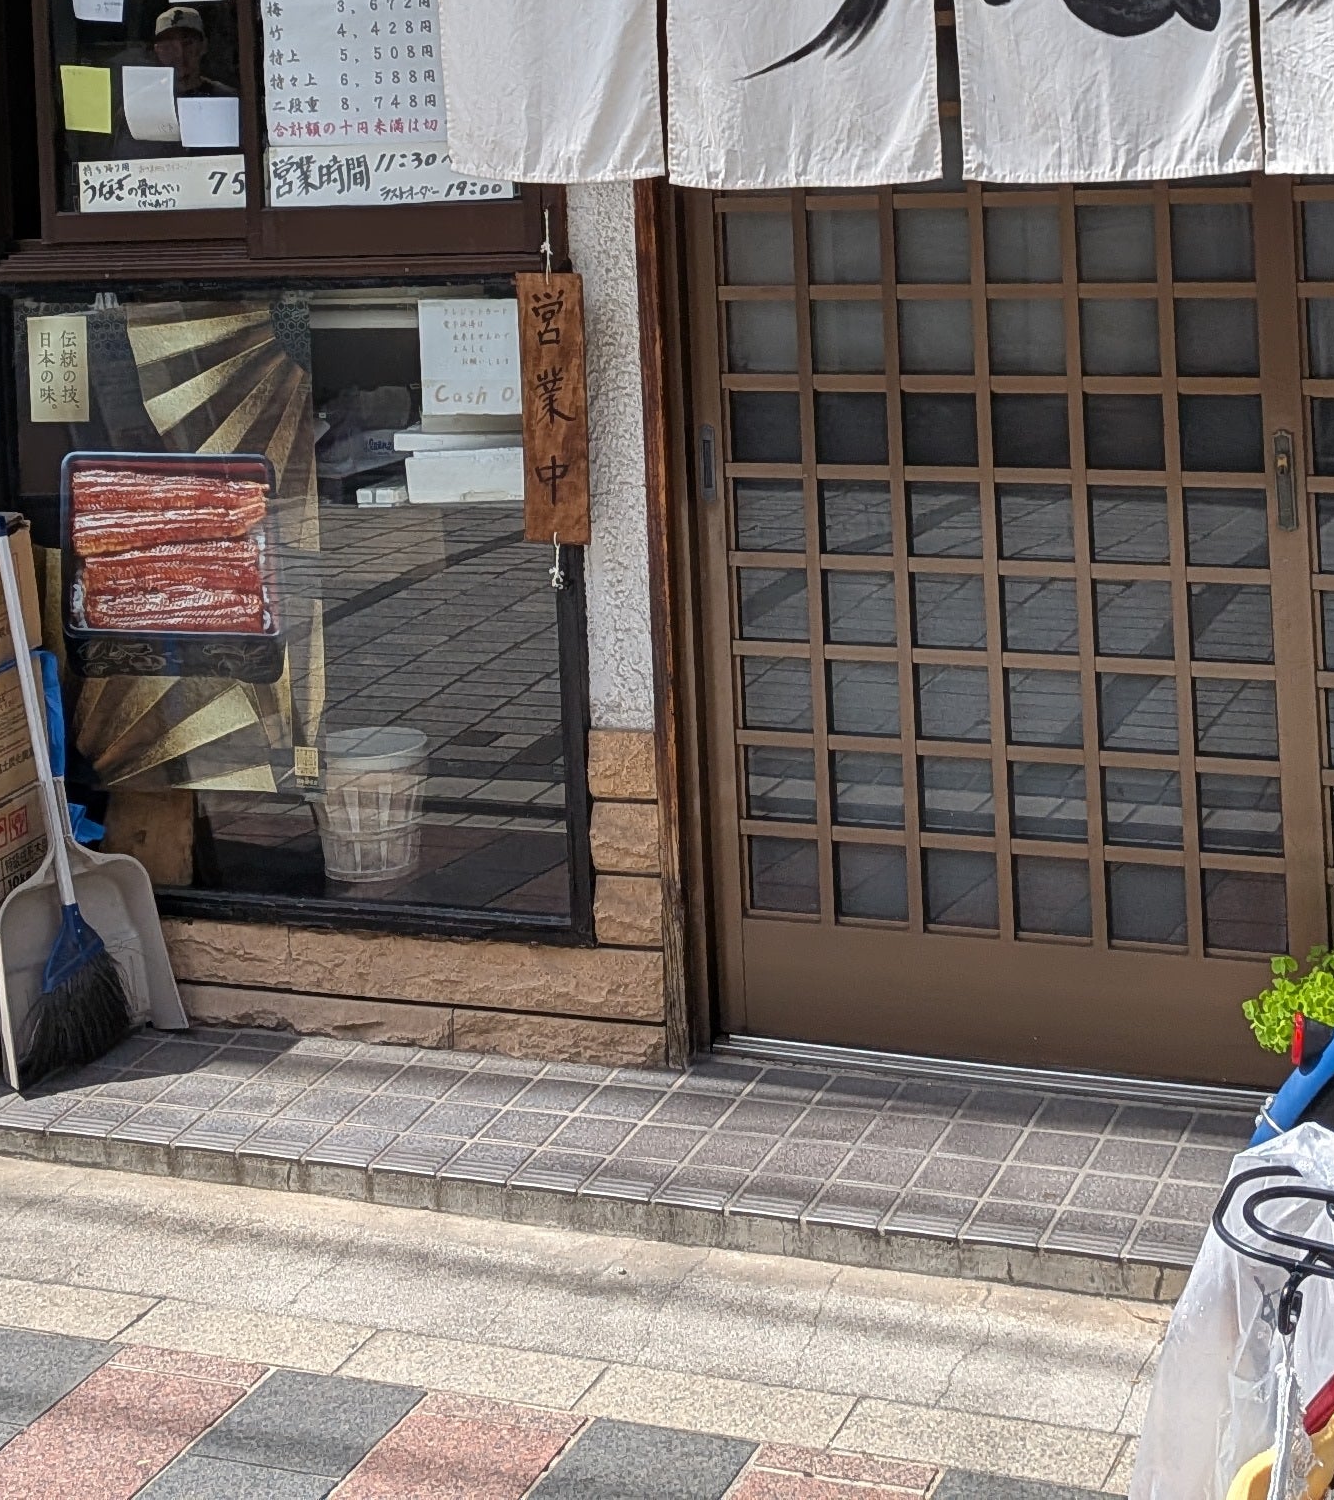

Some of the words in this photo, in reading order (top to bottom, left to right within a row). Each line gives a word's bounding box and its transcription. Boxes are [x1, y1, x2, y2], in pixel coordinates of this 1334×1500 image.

[269, 25, 282, 41] 竹
[337, 20, 432, 39] 4,428円
[269, 48, 300, 64] 特上
[340, 44, 433, 63] 5,508円
[341, 69, 436, 88] 6,588円
[272, 98, 320, 114] 二段重
[341, 94, 436, 112] 8,748円
[272, 118, 447, 139] 合計額の十円未満は切
[270, 154, 372, 198] 営業時間
[83, 174, 180, 204] うなぎの骨せんべい
[445, 181, 502, 197] 19:00
[38, 330, 59, 412] 日本の味。
[60, 330, 80, 410] 伝統の技、
[434, 384, 488, 406] Cash
[531, 289, 576, 506] 営業中
